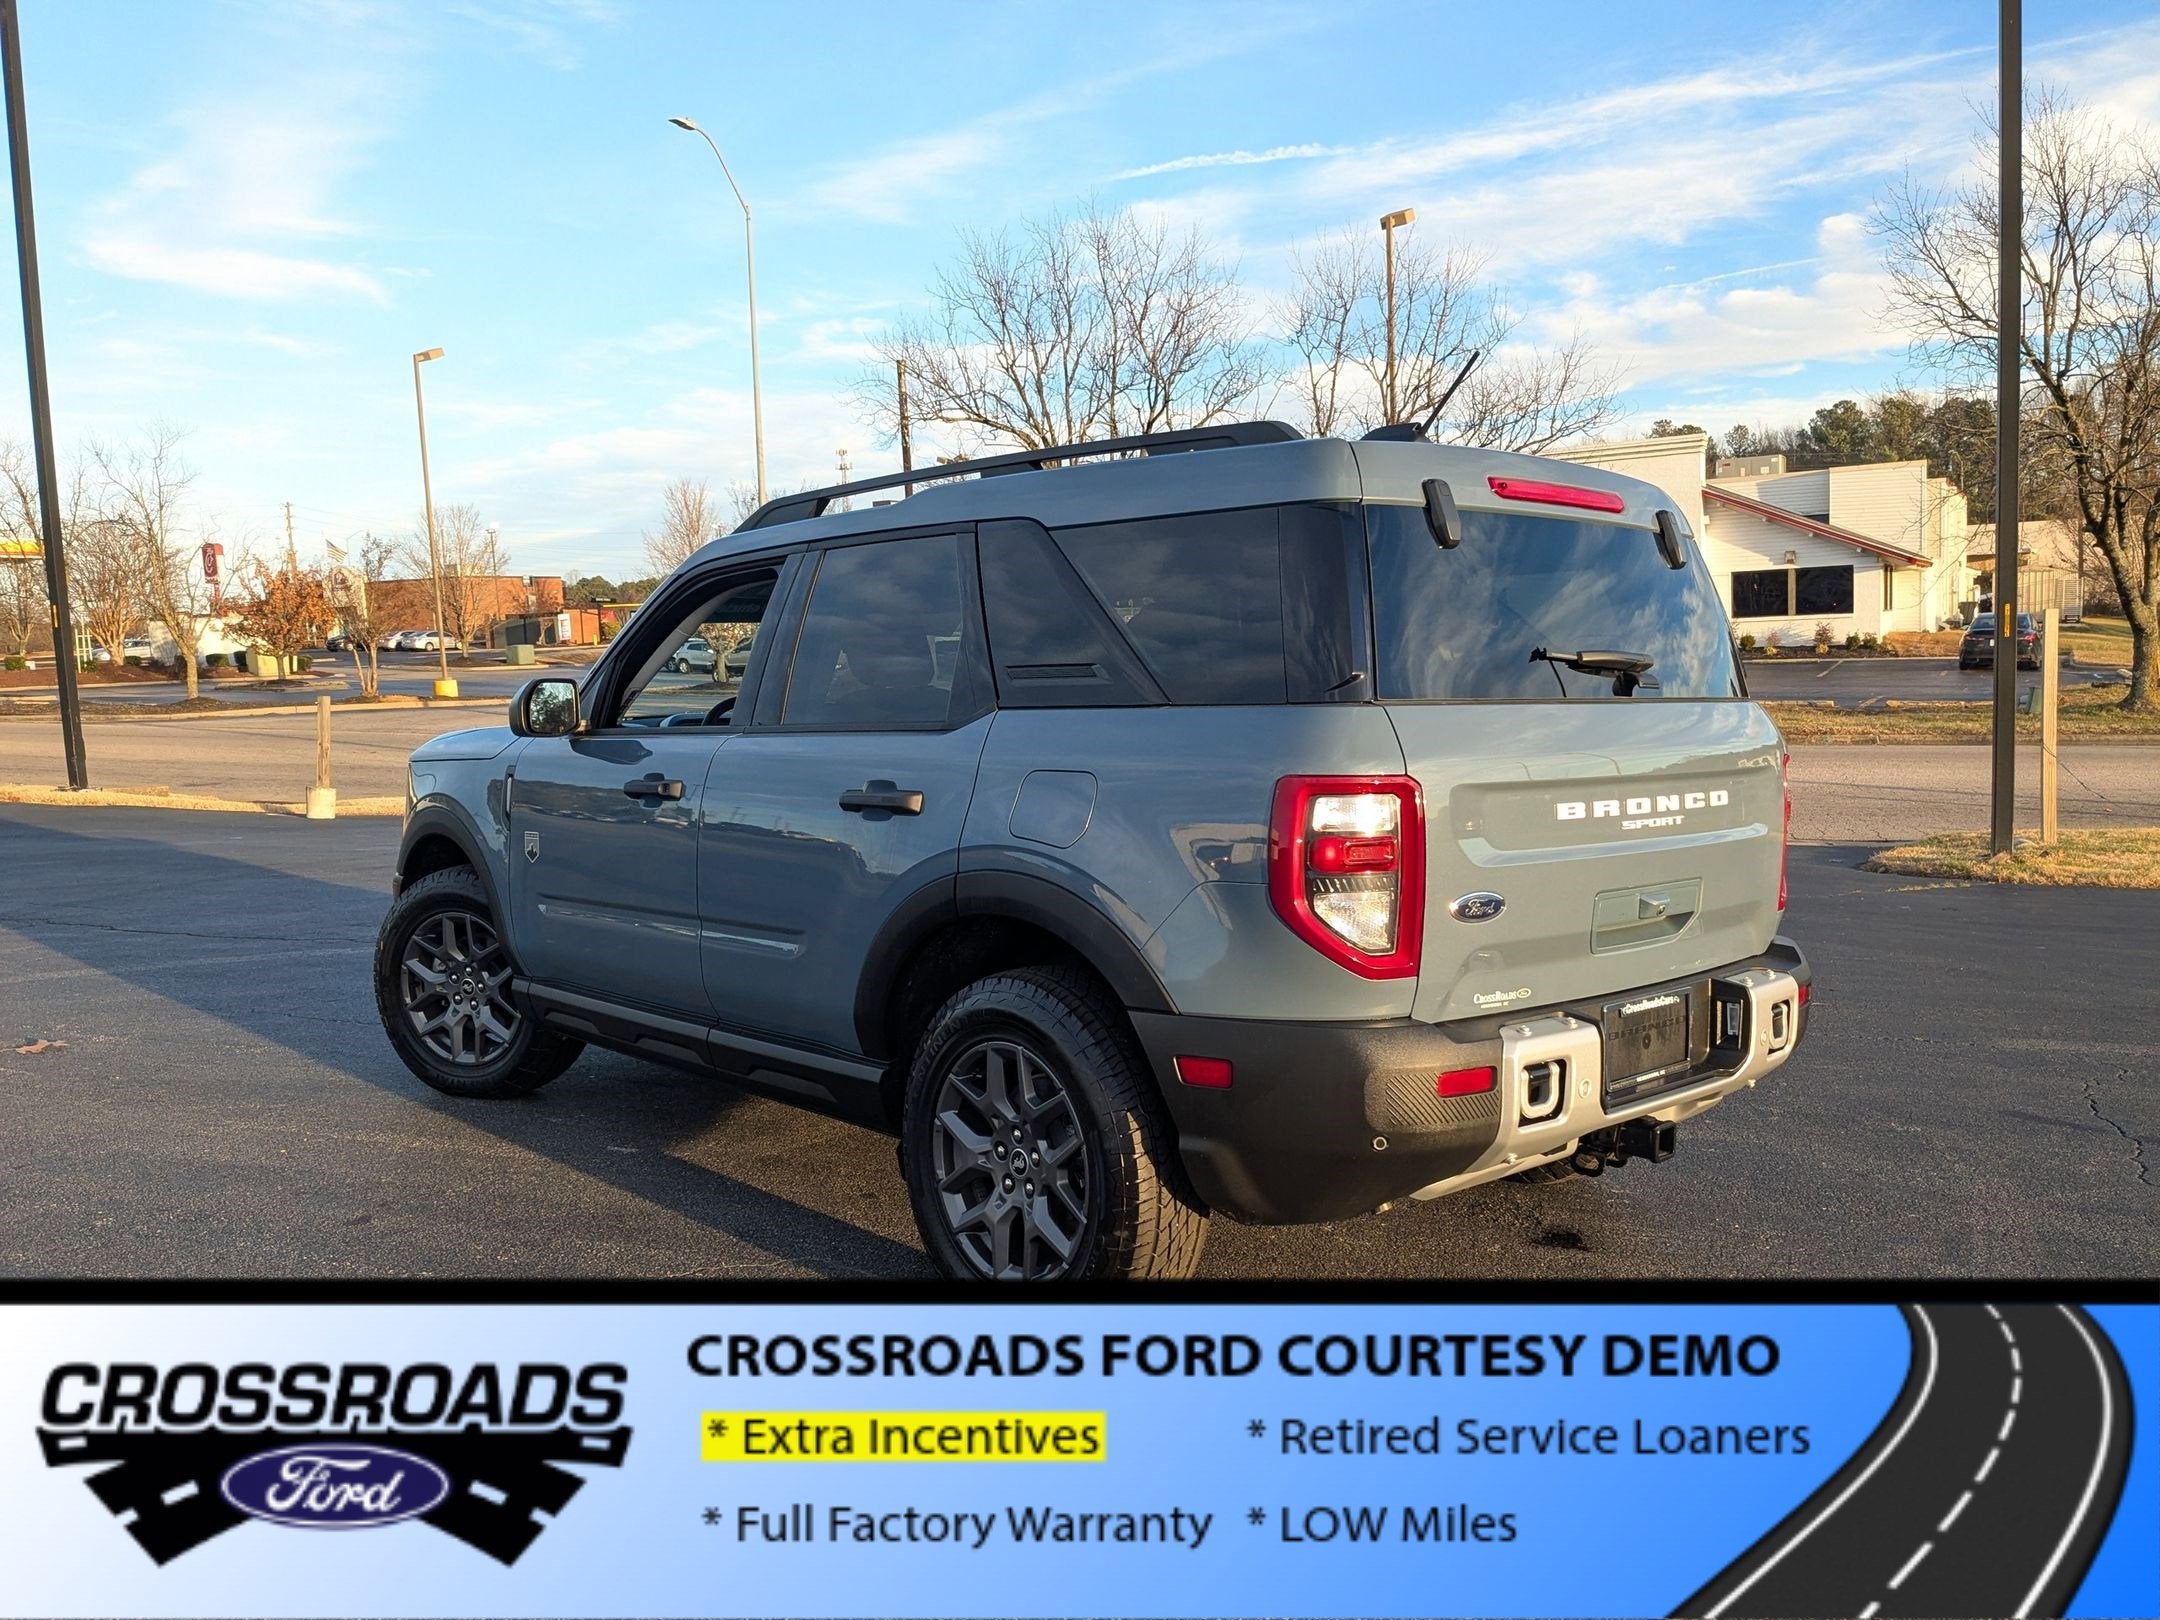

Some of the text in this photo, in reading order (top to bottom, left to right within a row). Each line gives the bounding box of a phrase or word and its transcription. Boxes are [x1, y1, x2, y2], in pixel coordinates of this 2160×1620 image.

[1555, 790, 1729, 821] BRONCO
[1621, 815, 1685, 830] SPORT
[1465, 899, 1495, 918] Ford
